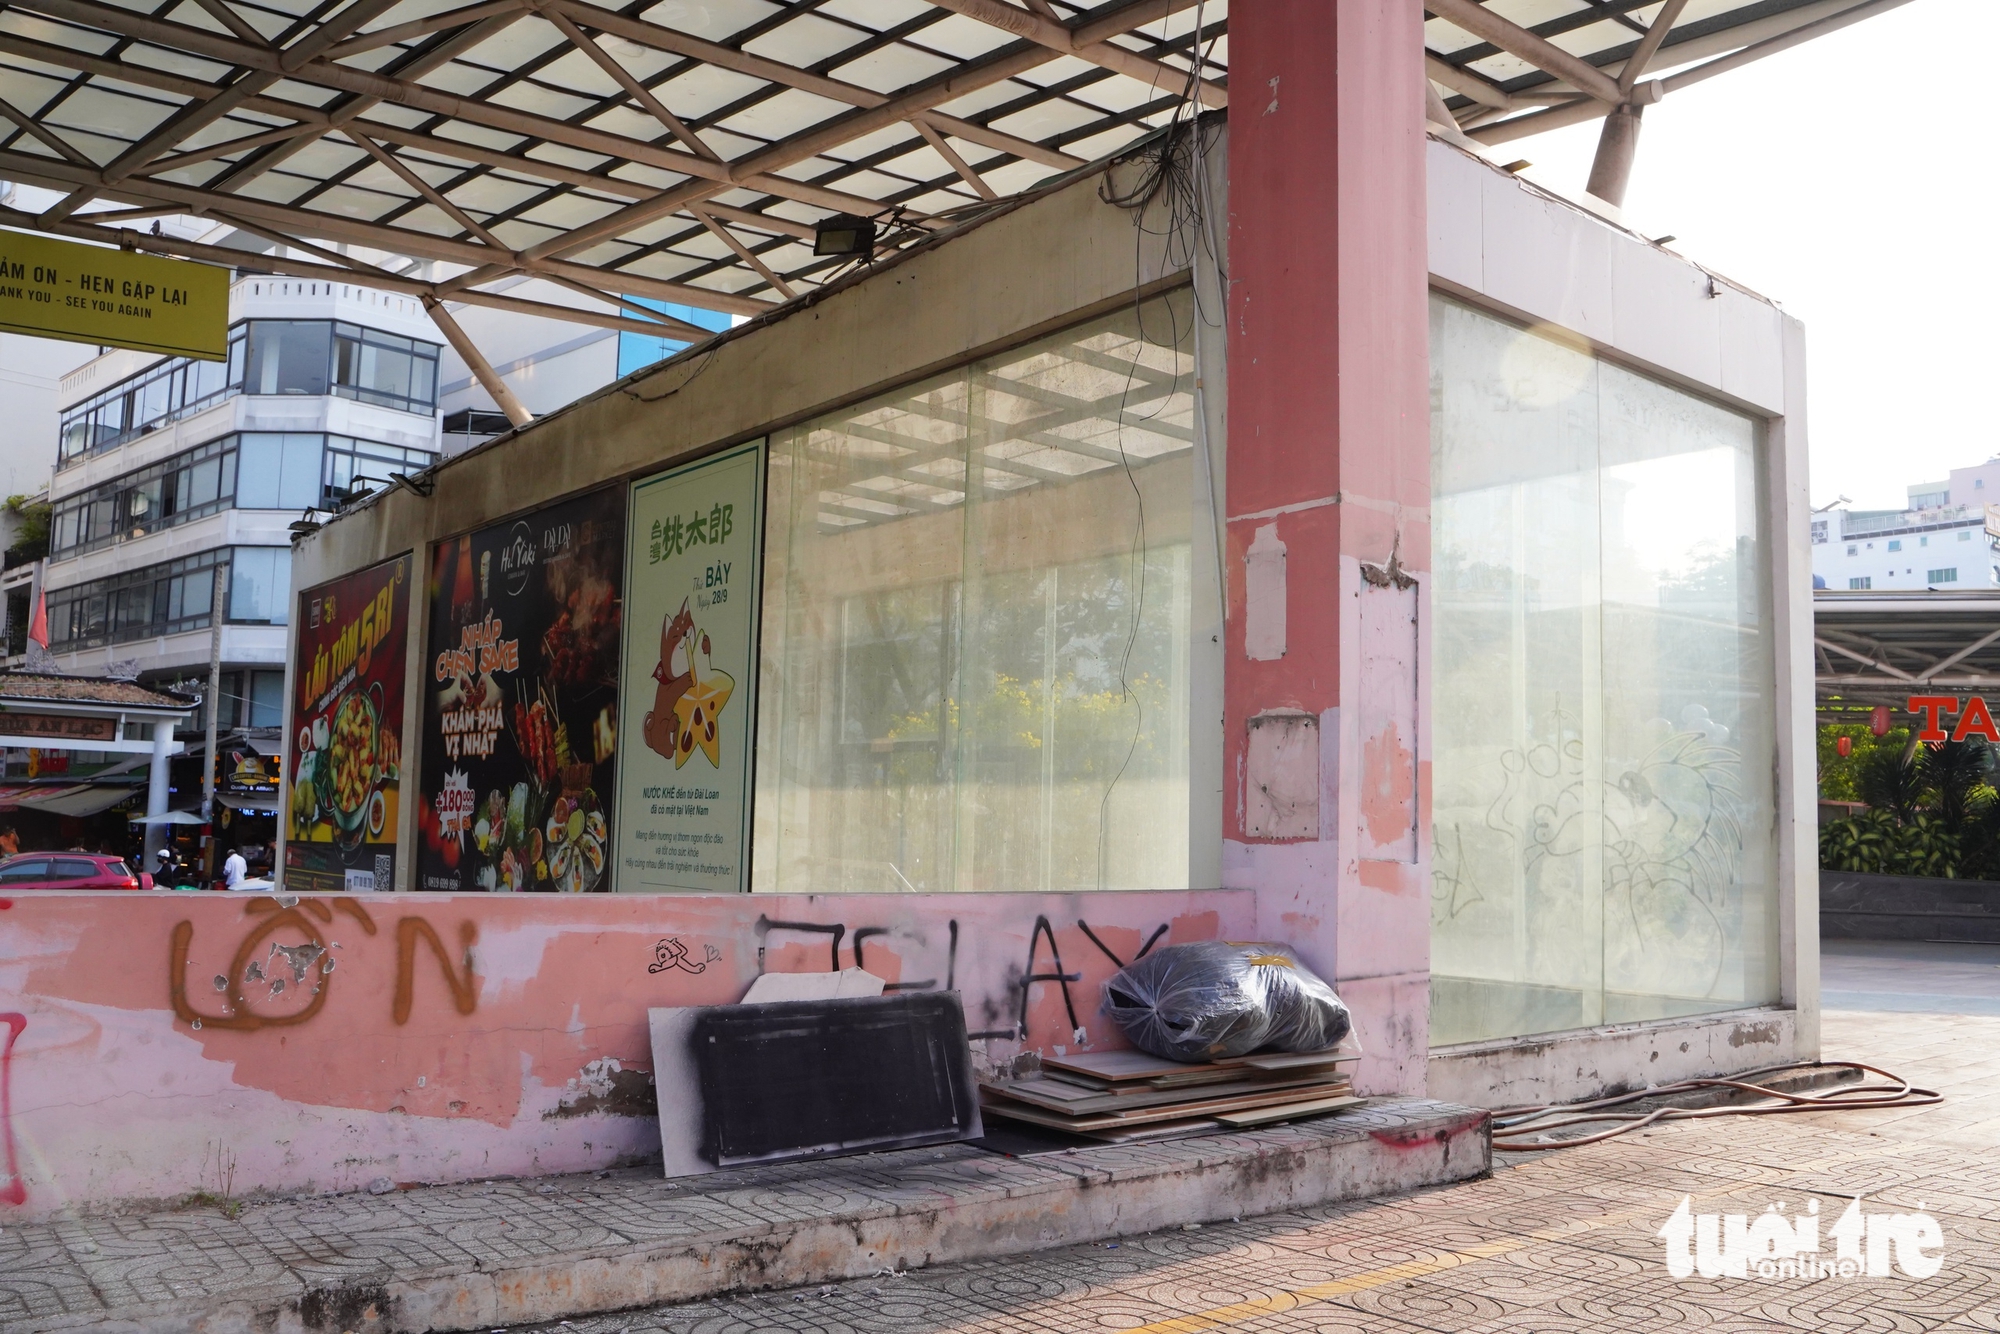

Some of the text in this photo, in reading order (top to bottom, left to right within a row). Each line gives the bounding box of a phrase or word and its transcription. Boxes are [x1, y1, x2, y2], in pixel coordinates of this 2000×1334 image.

[34, 266, 56, 285] ƠN
[81, 274, 114, 294] HẸN
[122, 281, 154, 301] GẶP
[162, 288, 187, 306] LẠI
[28, 290, 51, 303] YOU
[66, 296, 87, 308] SEE
[92, 300, 114, 312] YOU
[118, 304, 152, 318] AGAIN
[662, 503, 733, 561] 桃太郎
[706, 560, 732, 588] BẢY
[712, 589, 728, 604] 28/9
[462, 607, 502, 651] NHẤP
[304, 643, 329, 711] LẨU
[331, 617, 360, 683] TÔM
[479, 638, 519, 675] SAKE
[441, 700, 504, 734] KHÁM PHÁ
[1907, 696, 2000, 742] TA
[445, 727, 498, 762] VỊ NHẬT
[643, 785, 661, 799] NƯỚC
[676, 786, 686, 799] đến
[694, 788, 704, 799] Đài
[705, 789, 719, 799] Loan
[658, 804, 665, 814] có
[665, 805, 676, 817] mặt
[685, 804, 695, 818] Việt
[696, 805, 709, 815] Nam
[635, 830, 648, 842] Mang
[691, 833, 703, 845] ngon
[646, 859, 657, 869] nhau
